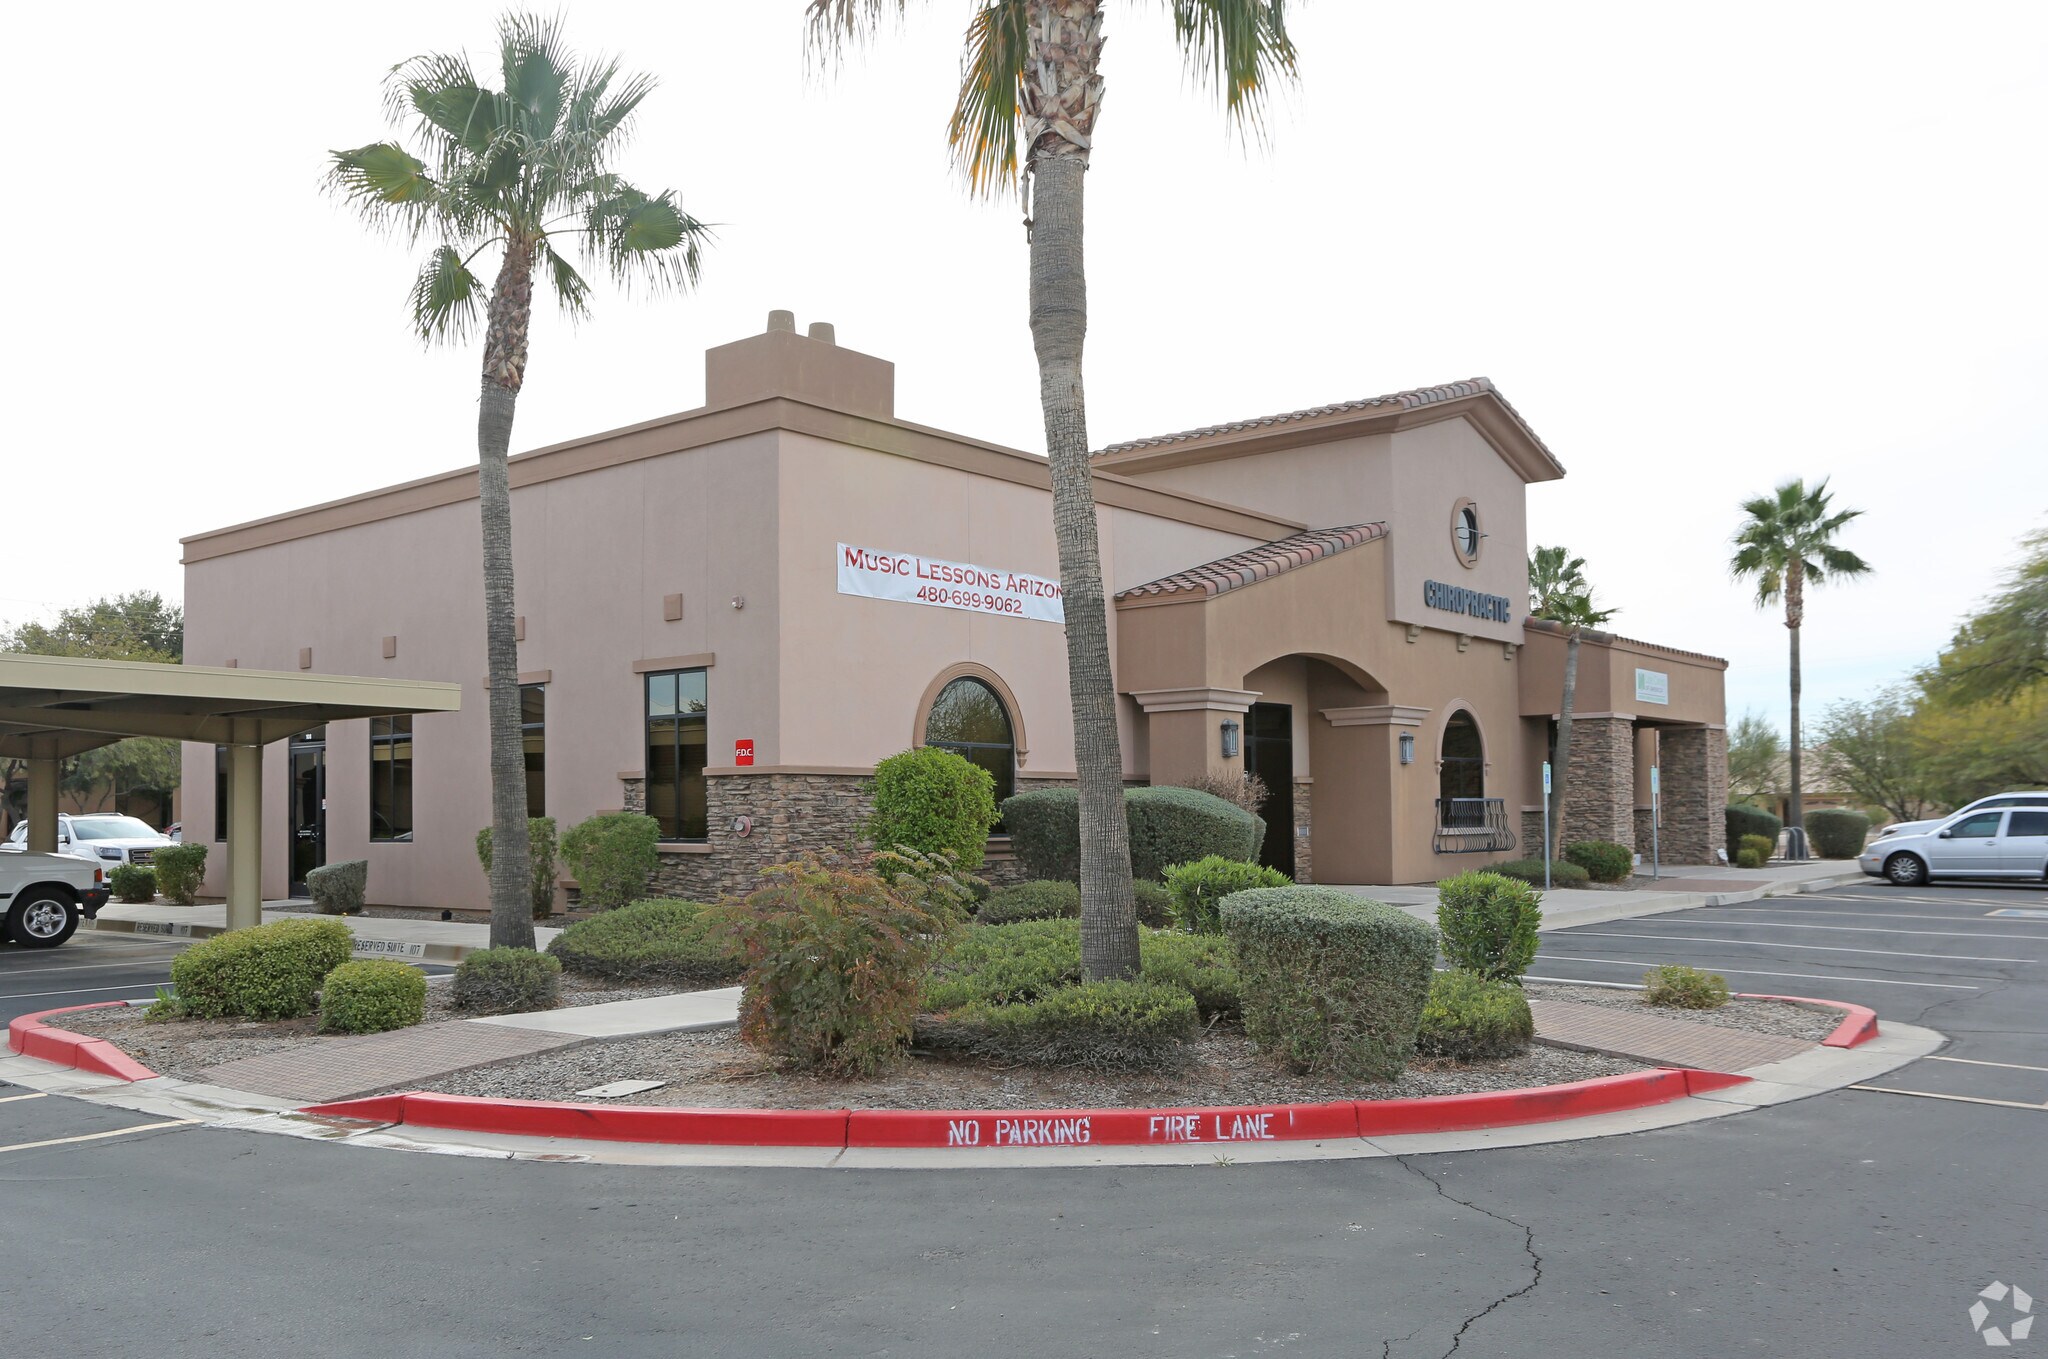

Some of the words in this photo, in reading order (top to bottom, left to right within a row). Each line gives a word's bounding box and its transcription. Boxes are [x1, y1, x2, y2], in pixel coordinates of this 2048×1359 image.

[916, 586, 1023, 614] 480-699-9062
[1005, 574, 1063, 599] ARIZON
[1424, 580, 1511, 623] CHIROPRACTIC
[354, 940, 385, 952] RESERVED
[387, 942, 405, 953] SUITE
[949, 1120, 980, 1145] NO
[995, 1116, 1091, 1144] PARKING
[1150, 1114, 1200, 1141] FIRE
[1216, 1113, 1274, 1140] LANE
